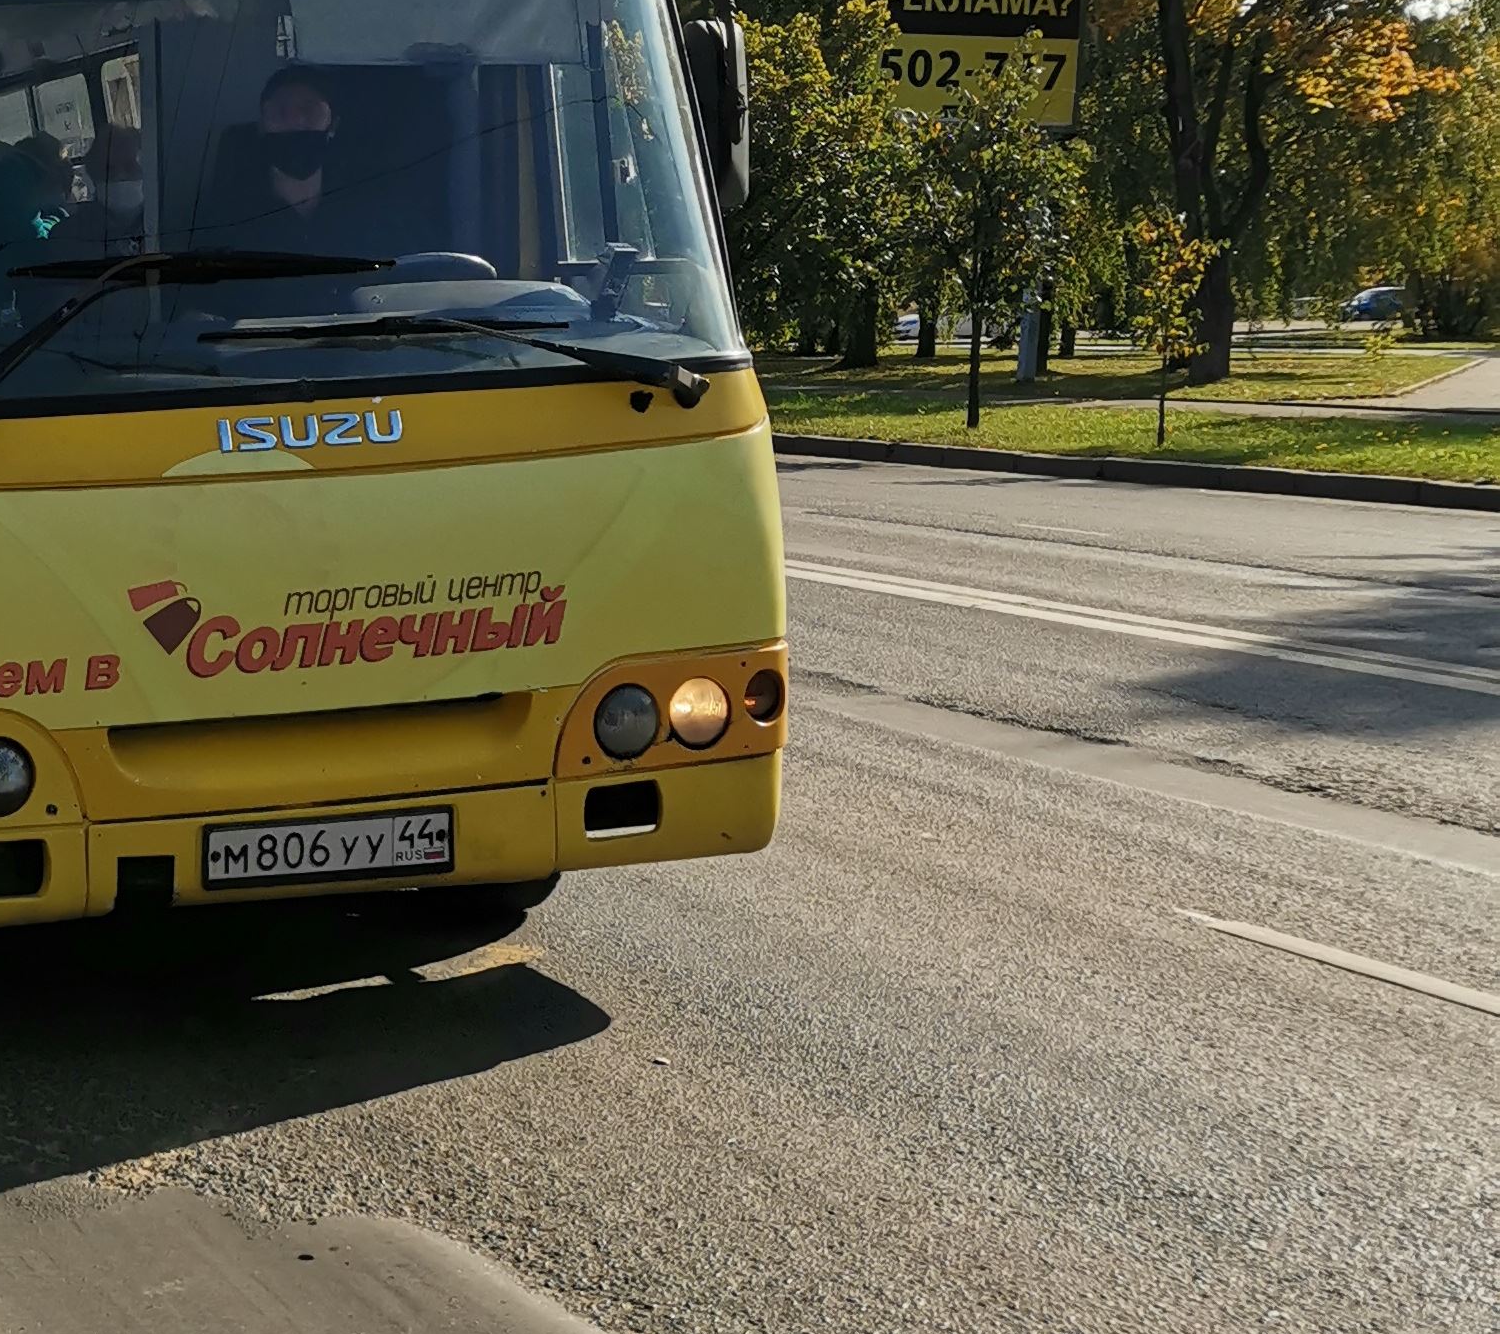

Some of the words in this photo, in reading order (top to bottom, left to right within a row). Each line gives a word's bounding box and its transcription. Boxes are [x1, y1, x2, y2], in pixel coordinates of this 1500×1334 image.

[880, 48, 1067, 92] 502-77
[217, 409, 404, 454] ISUZU
[284, 573, 436, 620] торговый
[447, 570, 543, 604] центр
[186, 584, 568, 679] Солнечный
[84, 654, 121, 691] в
[395, 849, 423, 862] RUS
[398, 818, 435, 849] 44
